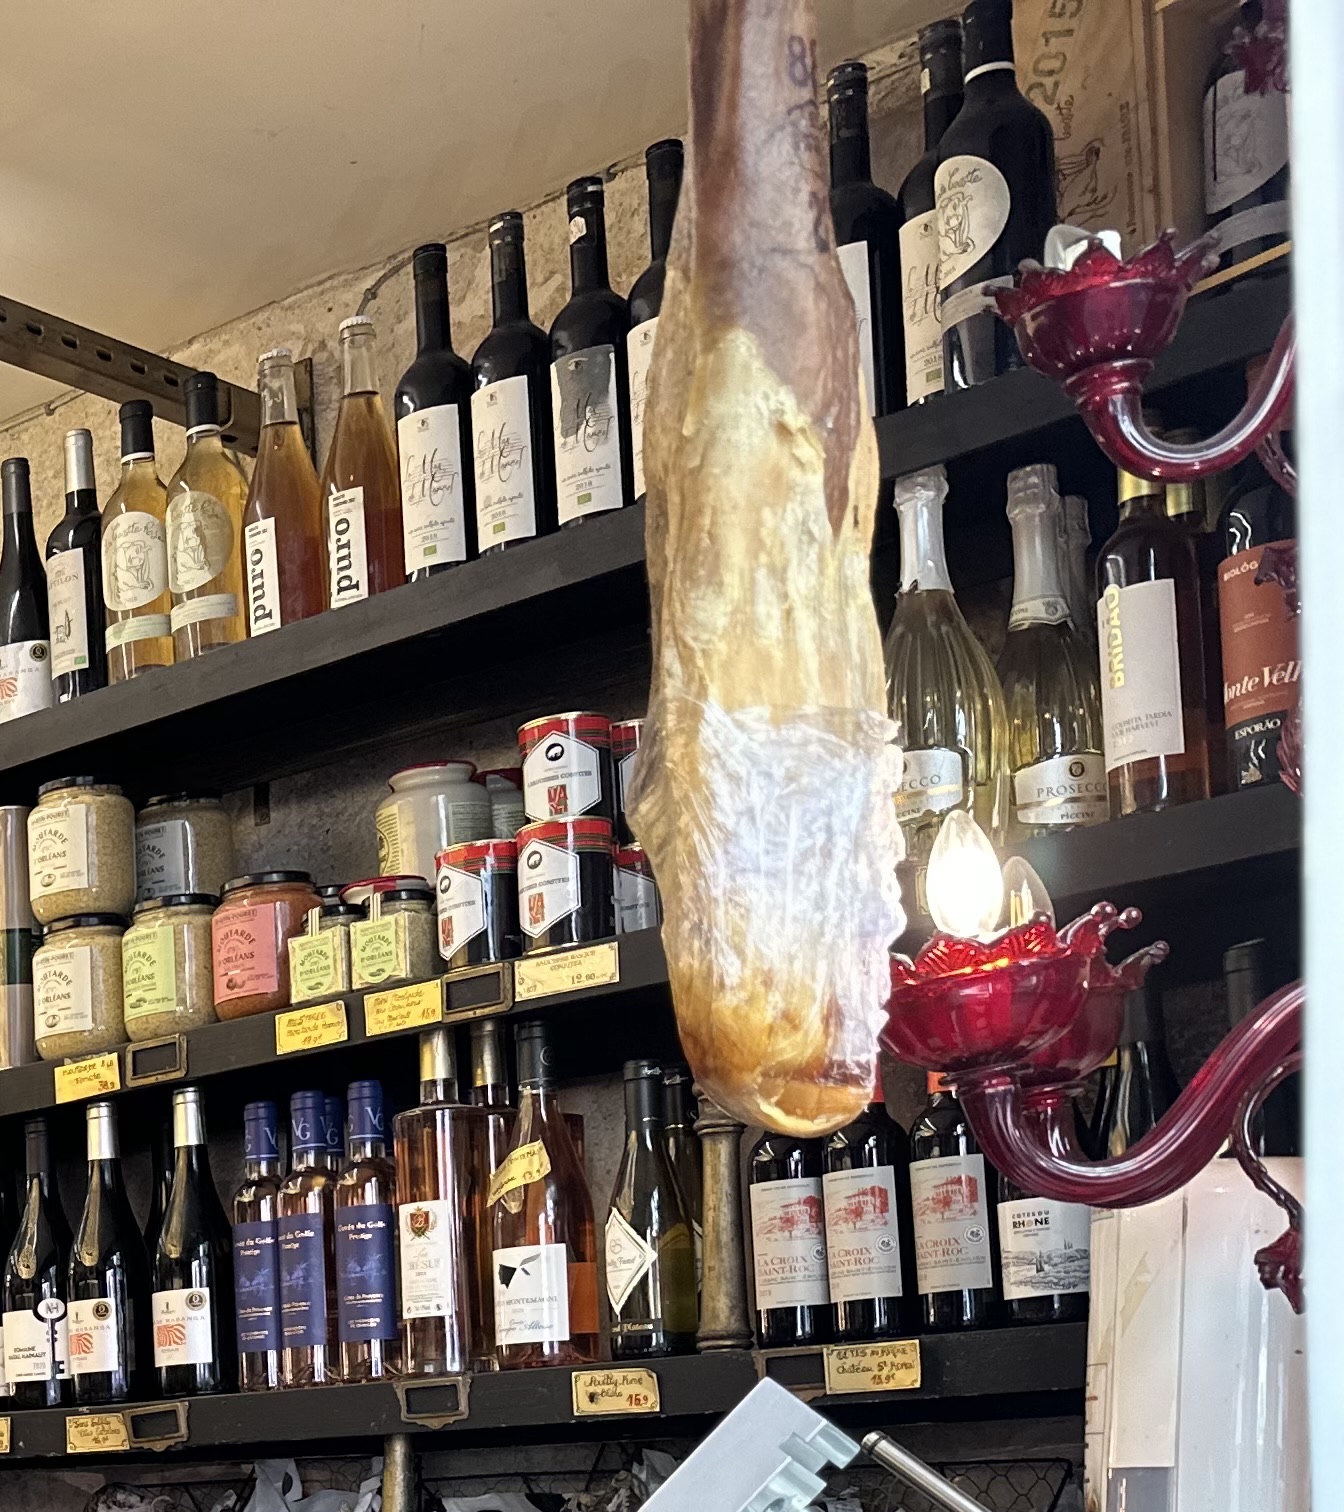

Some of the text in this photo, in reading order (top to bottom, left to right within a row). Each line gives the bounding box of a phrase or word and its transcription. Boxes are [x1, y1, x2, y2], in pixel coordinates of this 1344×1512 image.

[334, 516, 360, 595] puro
[246, 547, 273, 625] puro
[291, 1118, 311, 1141] VG
[926, 1237, 961, 1249] CROIX
[772, 1255, 807, 1266] CROIX
[840, 1247, 872, 1257] CROIX
